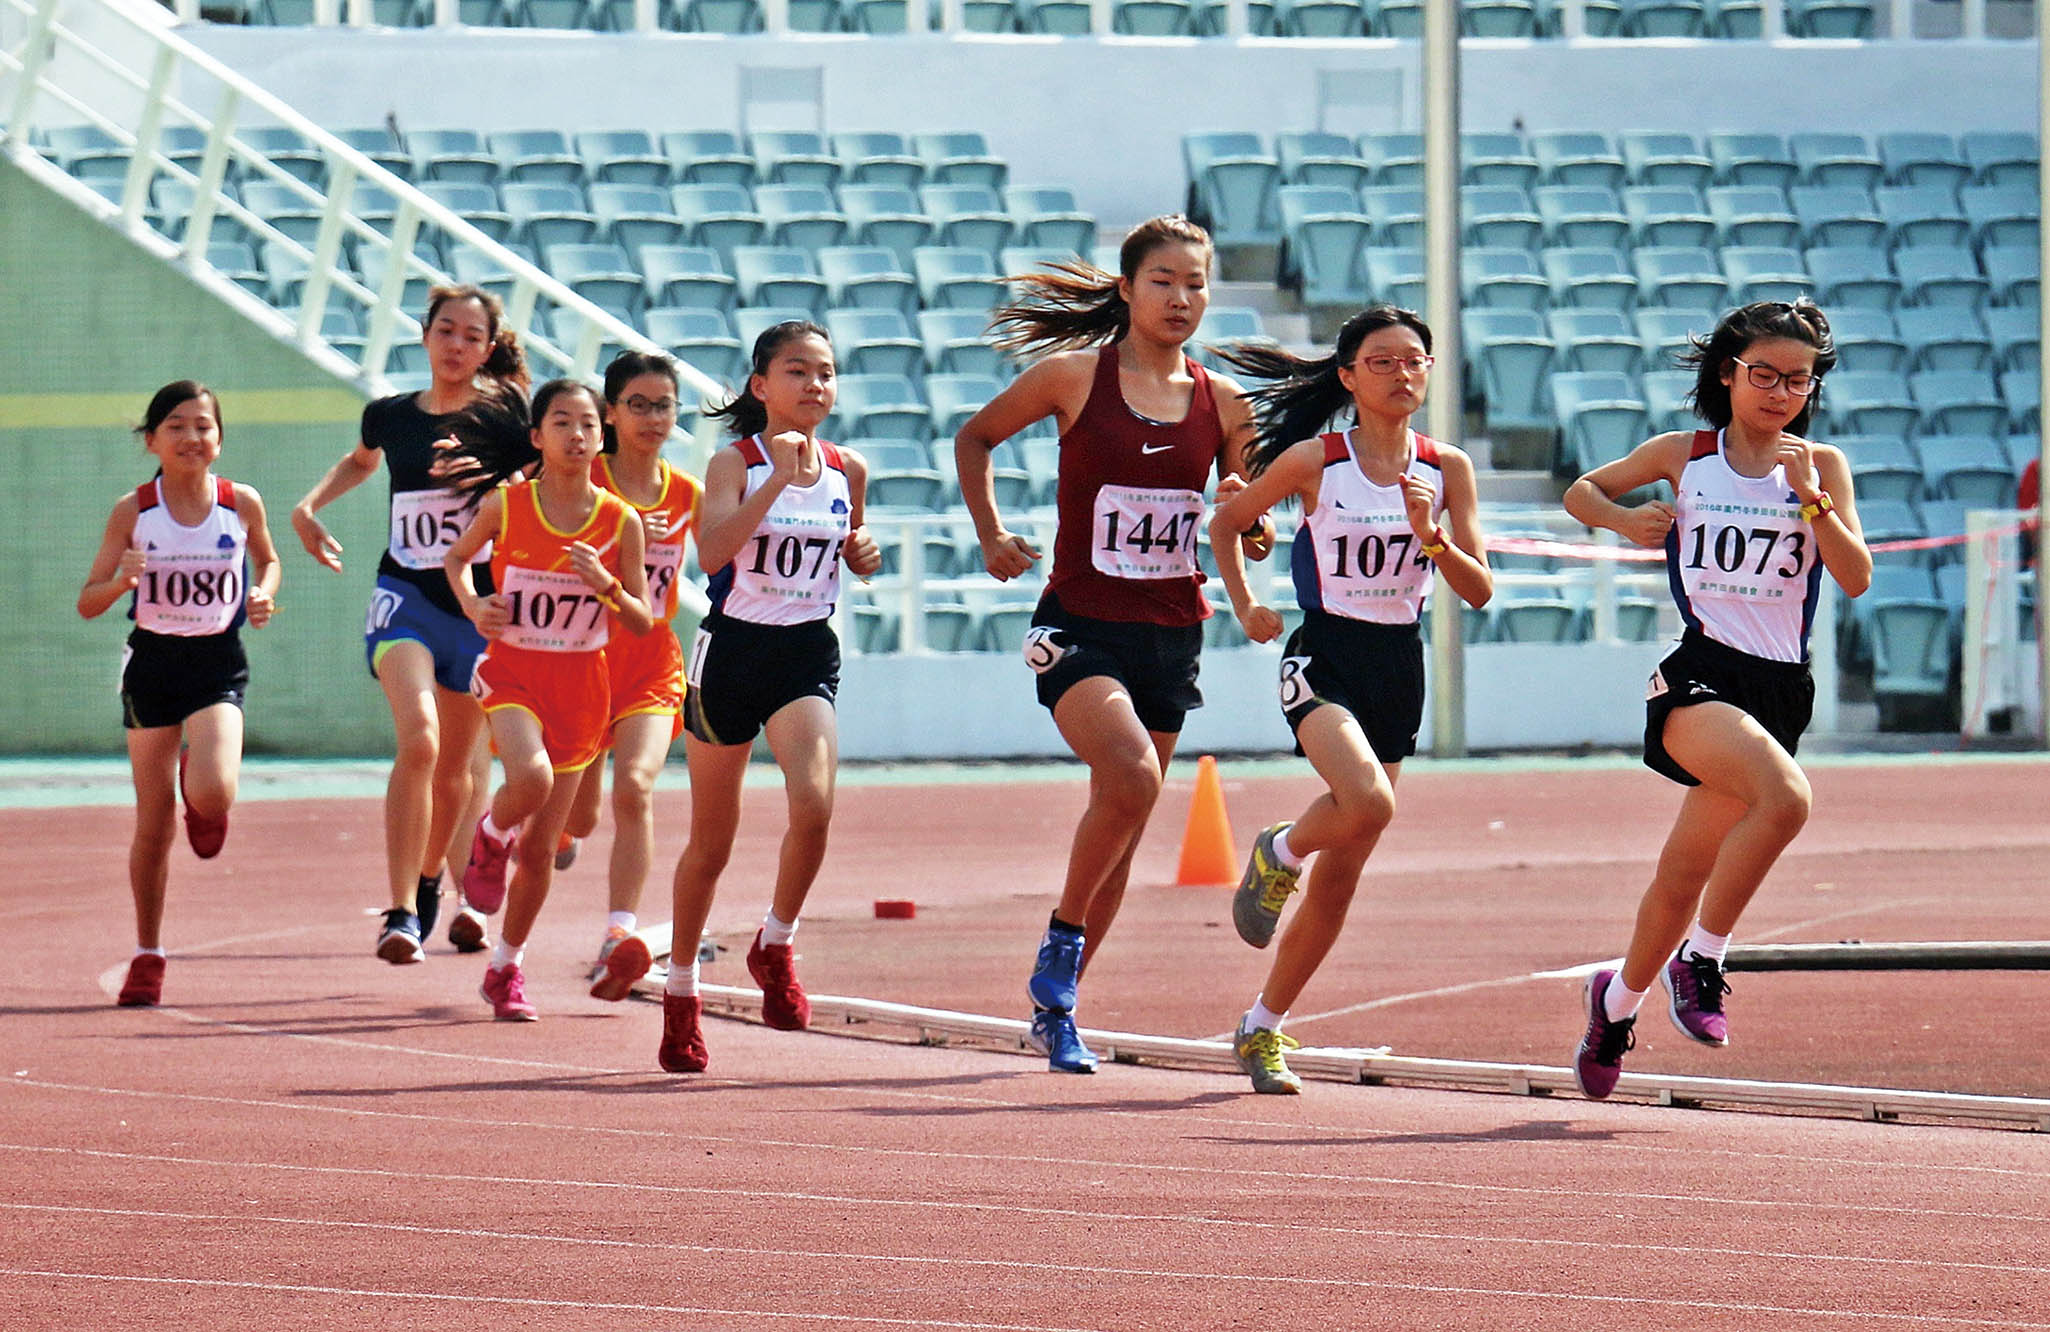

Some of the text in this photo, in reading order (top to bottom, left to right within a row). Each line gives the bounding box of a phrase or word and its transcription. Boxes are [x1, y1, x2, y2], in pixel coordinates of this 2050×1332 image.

[1101, 510, 1200, 554] 1447
[1685, 523, 1805, 578] 1073
[144, 569, 238, 606] 1080
[509, 590, 604, 630] 1077
